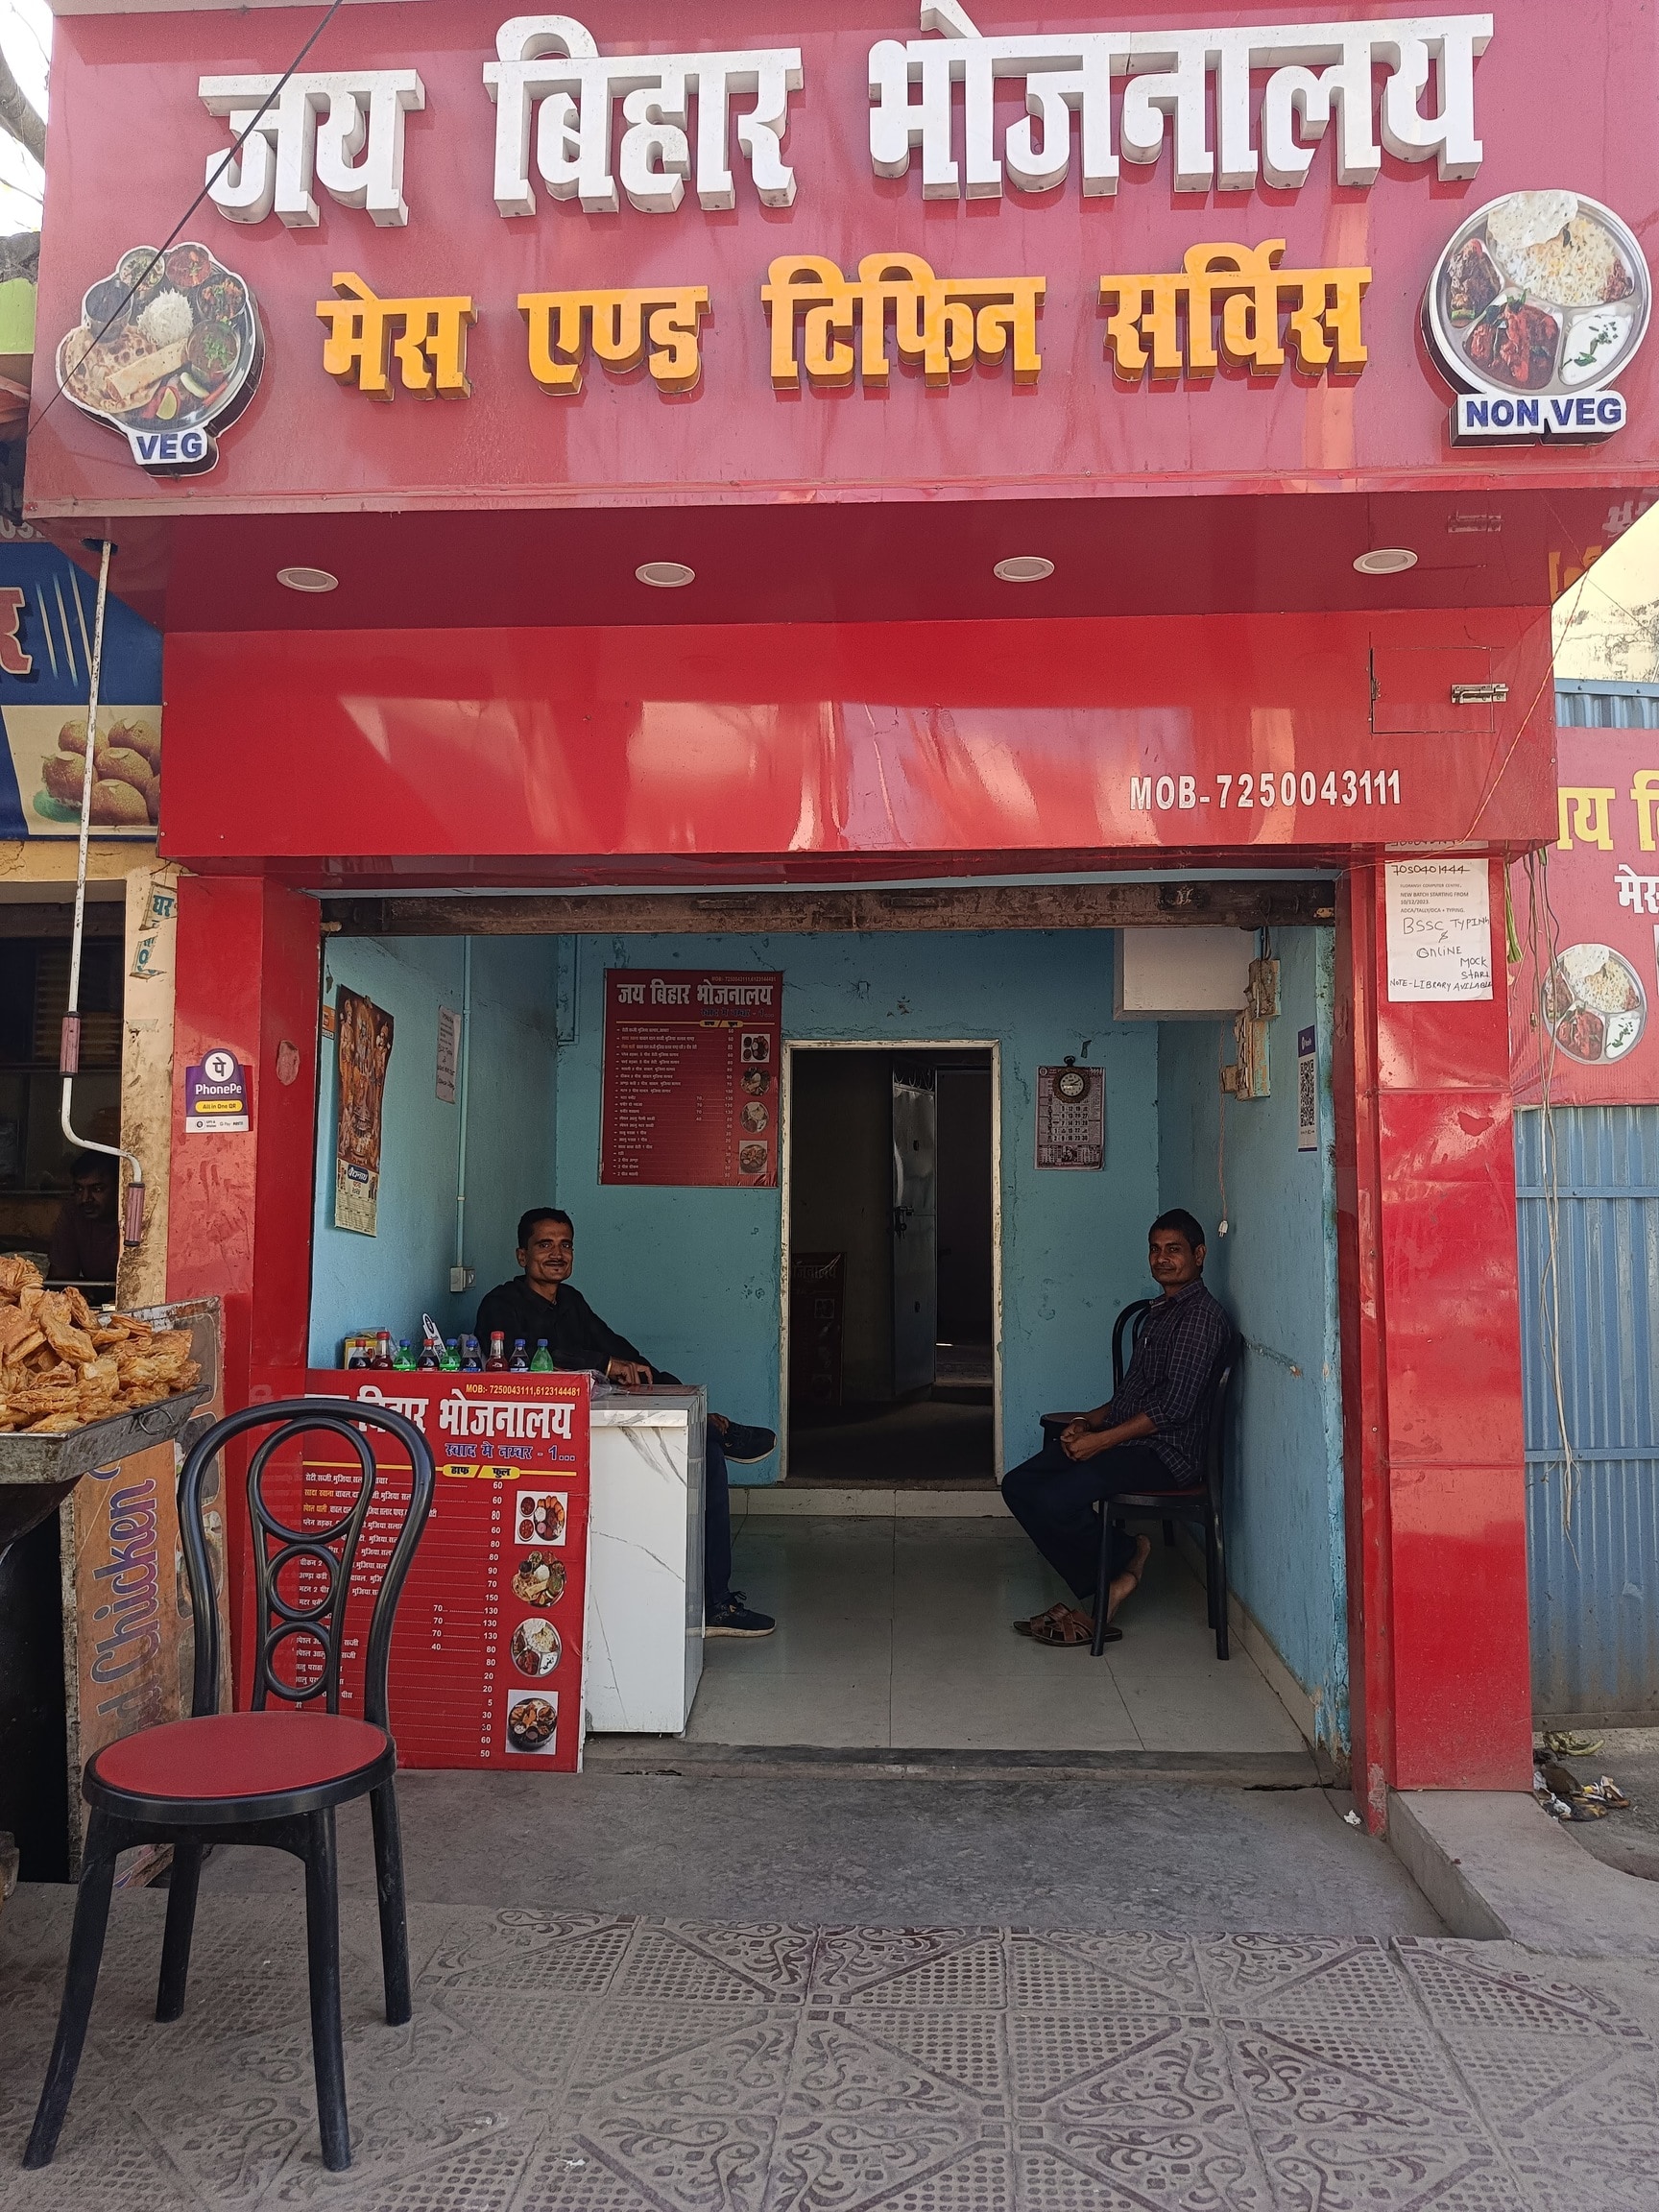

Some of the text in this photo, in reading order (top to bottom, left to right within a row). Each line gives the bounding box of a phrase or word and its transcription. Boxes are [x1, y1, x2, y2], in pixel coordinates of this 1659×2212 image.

[198, 0, 1494, 228] जय बिहार भोजनालय
[316, 238, 1372, 400] मेस एण्ड टिफिन सर्विस
[1466, 397, 1623, 429] NON VEG
[136, 432, 204, 461] VEG
[1403, 917, 1445, 935] BSSC
[616, 978, 774, 1005] जय बिहार भोजनालय
[212, 1056, 227, 1077] पे
[195, 1083, 242, 1094] PhonePe
[440, 1389, 576, 1439] भोजनालय
[445, 1442, 477, 1457] स्वाद
[493, 1480, 503, 1489] 60
[492, 1511, 500, 1521] 80
[91, 1479, 160, 1683] Chicken
[481, 1736, 491, 1744] 60
[480, 1749, 491, 1758] 50
